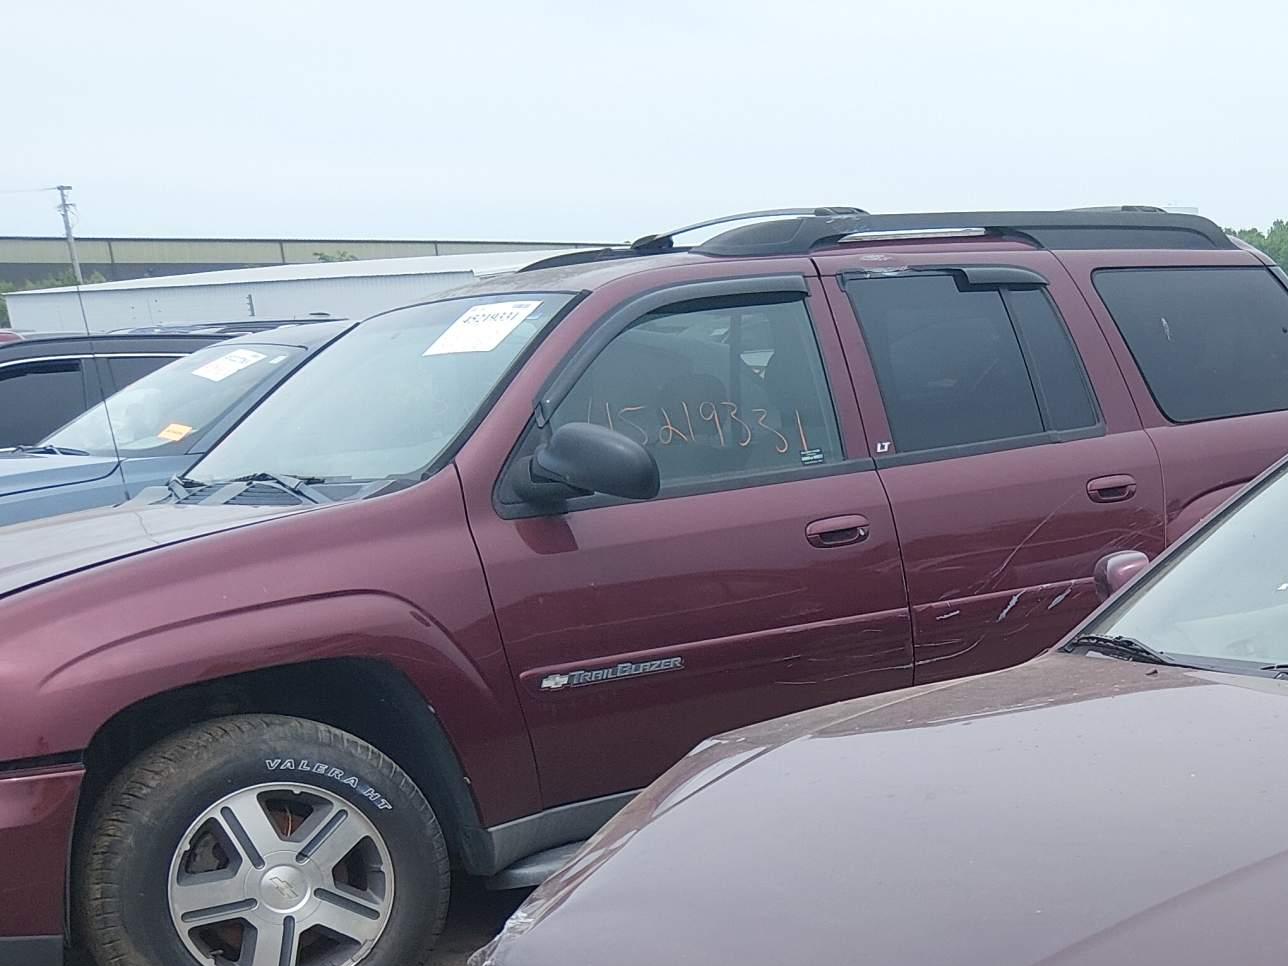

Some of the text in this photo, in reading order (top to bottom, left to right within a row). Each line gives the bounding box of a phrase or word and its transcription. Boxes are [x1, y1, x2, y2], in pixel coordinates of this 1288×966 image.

[876, 441, 891, 453] LT
[265, 758, 393, 810] VALERA HT
